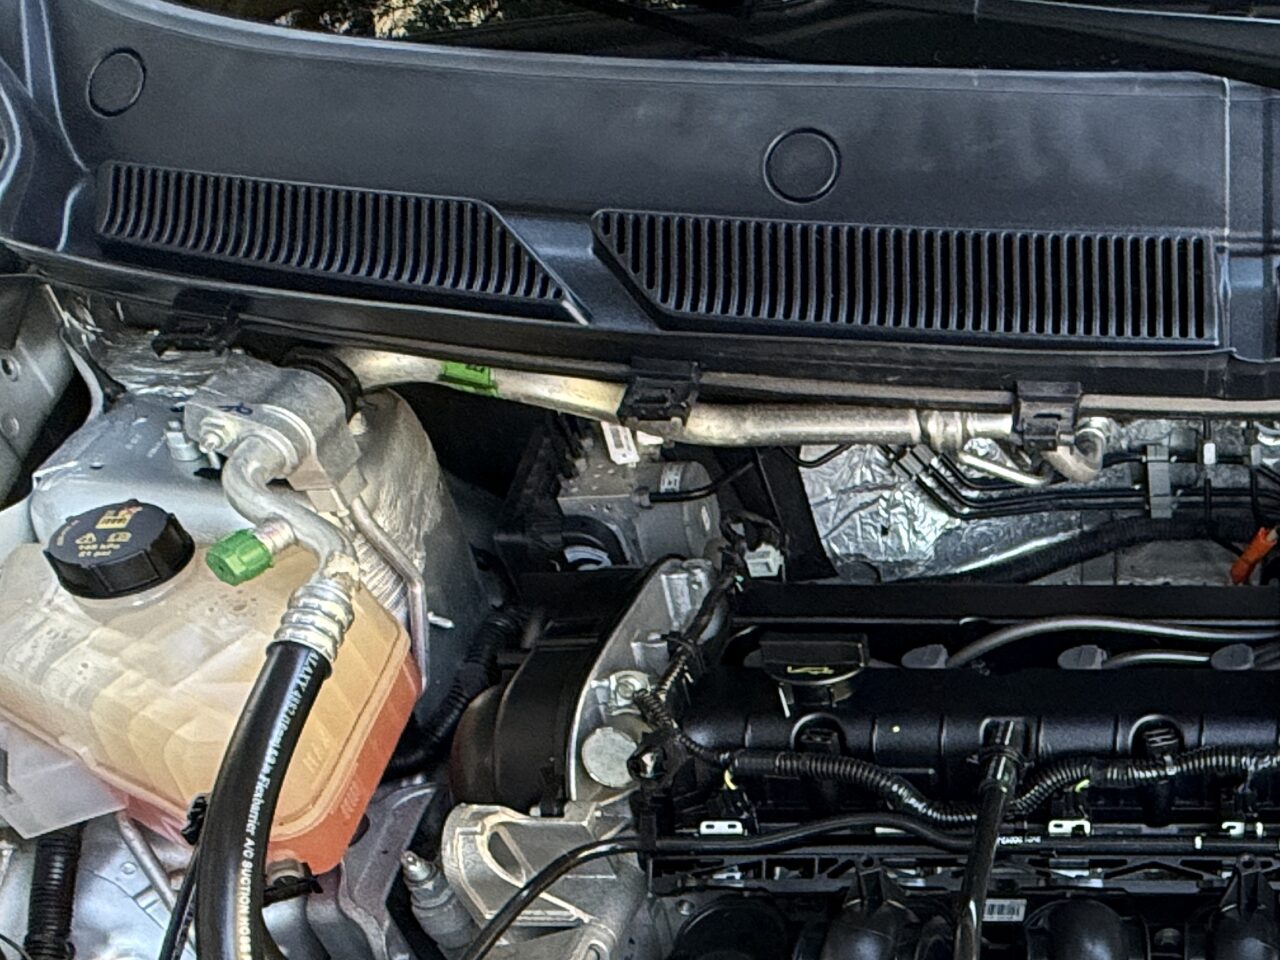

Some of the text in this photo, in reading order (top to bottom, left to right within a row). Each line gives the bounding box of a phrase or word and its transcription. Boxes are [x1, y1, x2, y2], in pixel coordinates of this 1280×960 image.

[246, 775, 270, 837] Flexbarrier
[243, 840, 256, 861] A/C
[238, 862, 254, 915] SUCTION
[239, 917, 251, 951] HOSE
